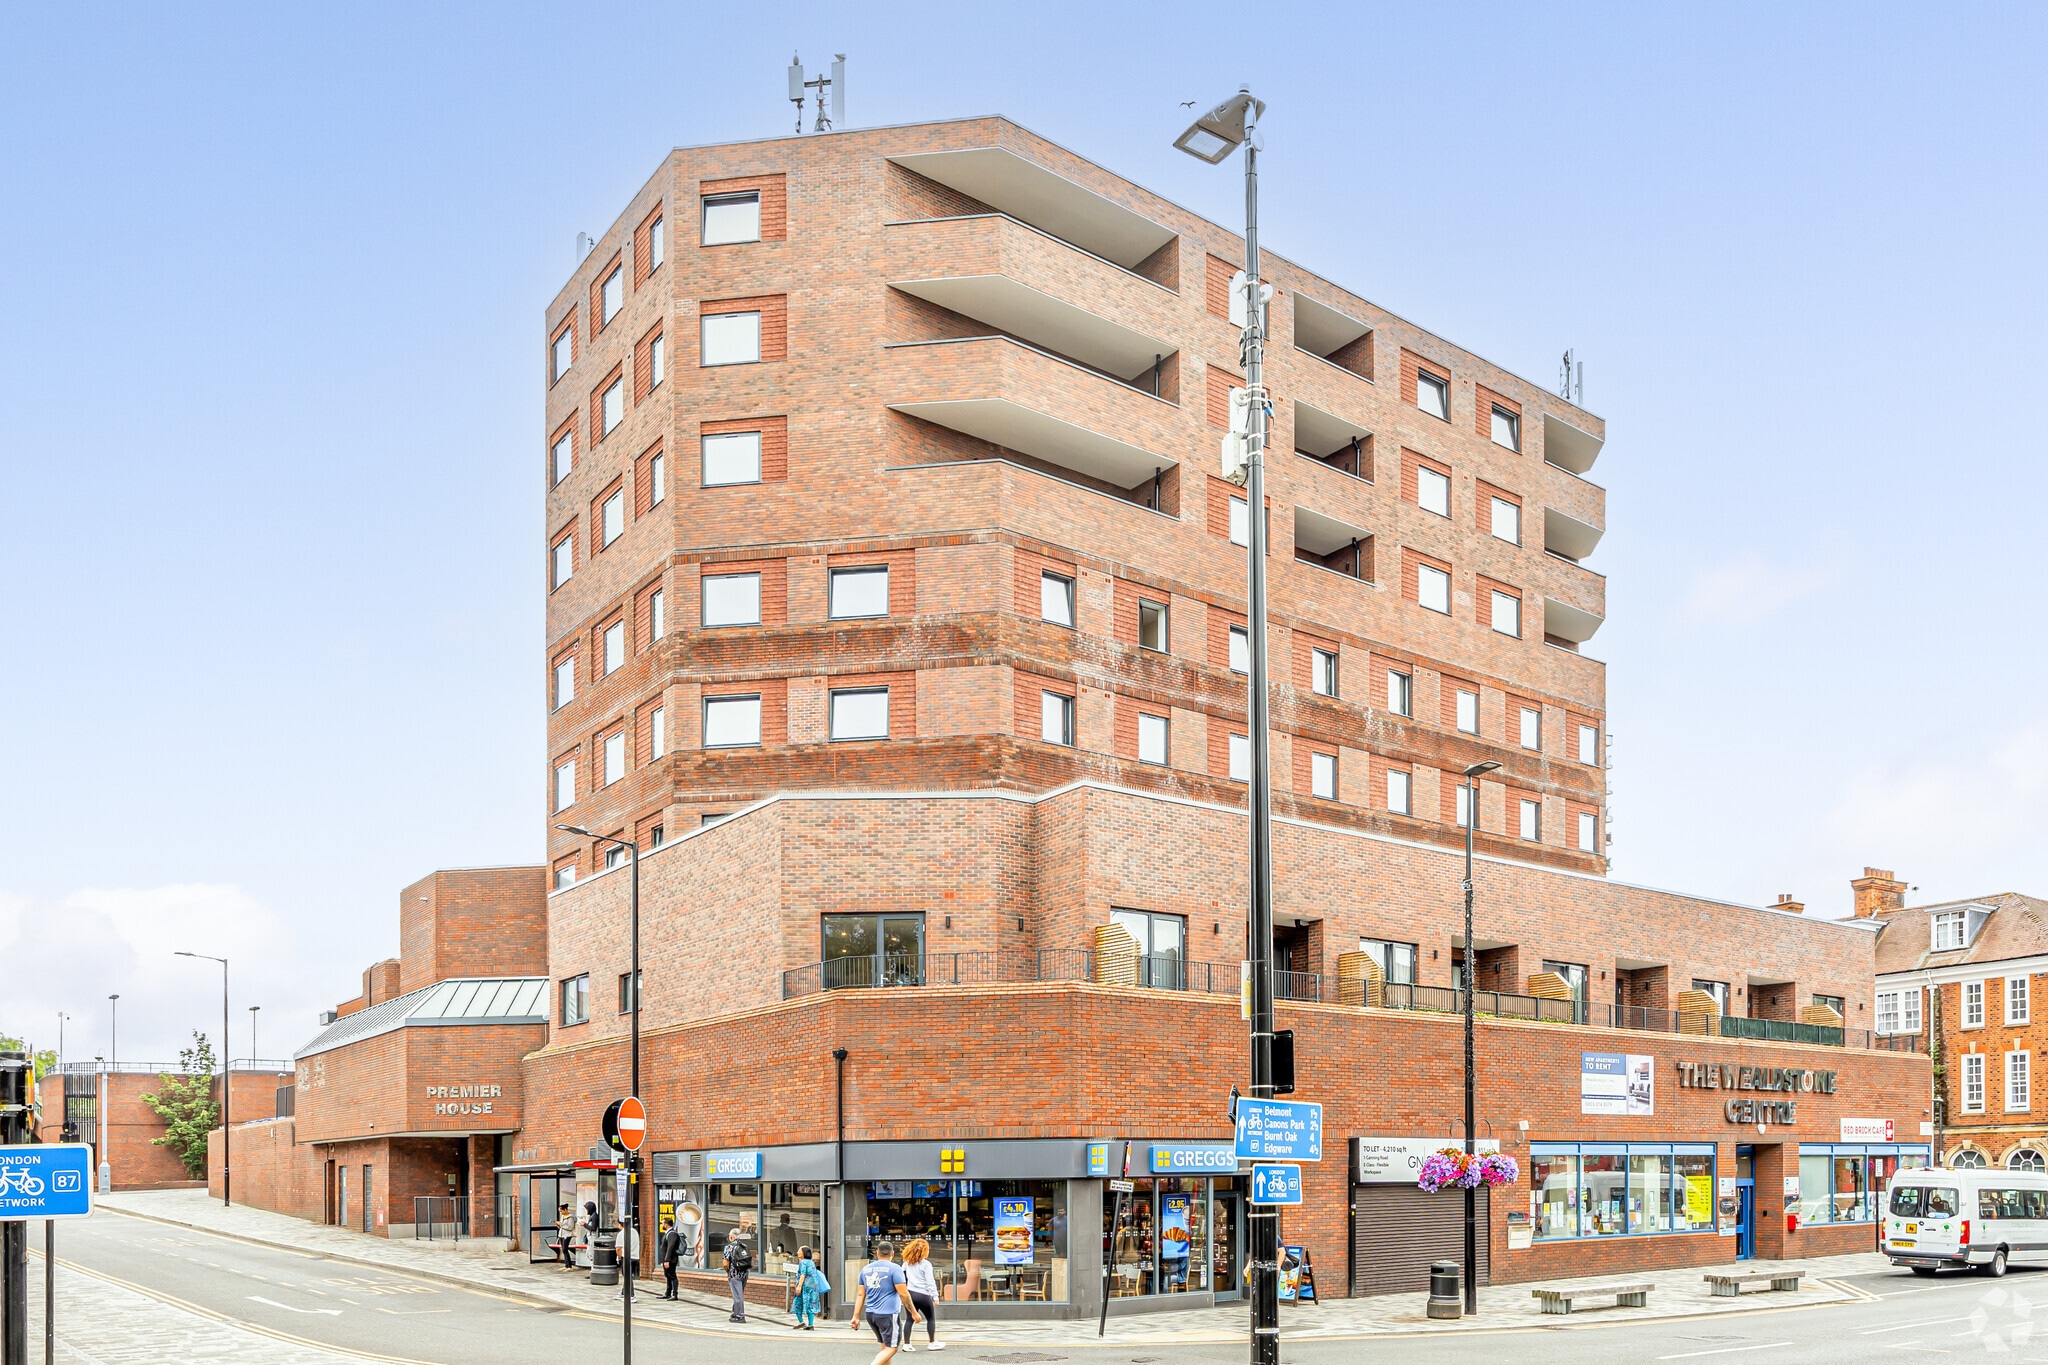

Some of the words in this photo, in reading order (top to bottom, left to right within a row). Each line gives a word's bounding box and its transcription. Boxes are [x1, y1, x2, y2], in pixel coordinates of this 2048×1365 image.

[1677, 1062, 1719, 1088] THE
[1719, 1063, 1838, 1094] WEALDSTONE
[426, 1085, 502, 1099] PREMIER
[435, 1101, 493, 1115] HOUSE
[1264, 1106, 1292, 1117] Belmont
[1724, 1098, 1797, 1124] CENTRE
[1264, 1118, 1288, 1129] Canons
[1290, 1119, 1305, 1130] Park
[1843, 1126, 1853, 1134] RED
[1855, 1126, 1871, 1134] BRICK
[1264, 1131, 1283, 1141] Burnt
[1284, 1131, 1298, 1142] Oak
[1309, 1132, 1315, 1142] 4
[1264, 1143, 1292, 1155] Edgware
[0, 1155, 41, 1166] ONDON
[1173, 1150, 1234, 1167] GREGGS
[717, 1158, 755, 1174] GREGGS
[57, 1175, 77, 1188] 87
[659, 1189, 673, 1201] BUSY
[673, 1189, 686, 1201] DAY?
[0, 1197, 46, 1208] ETWORK
[1003, 1203, 1024, 1213] £4.10
[1168, 1200, 1185, 1209] £2.95
